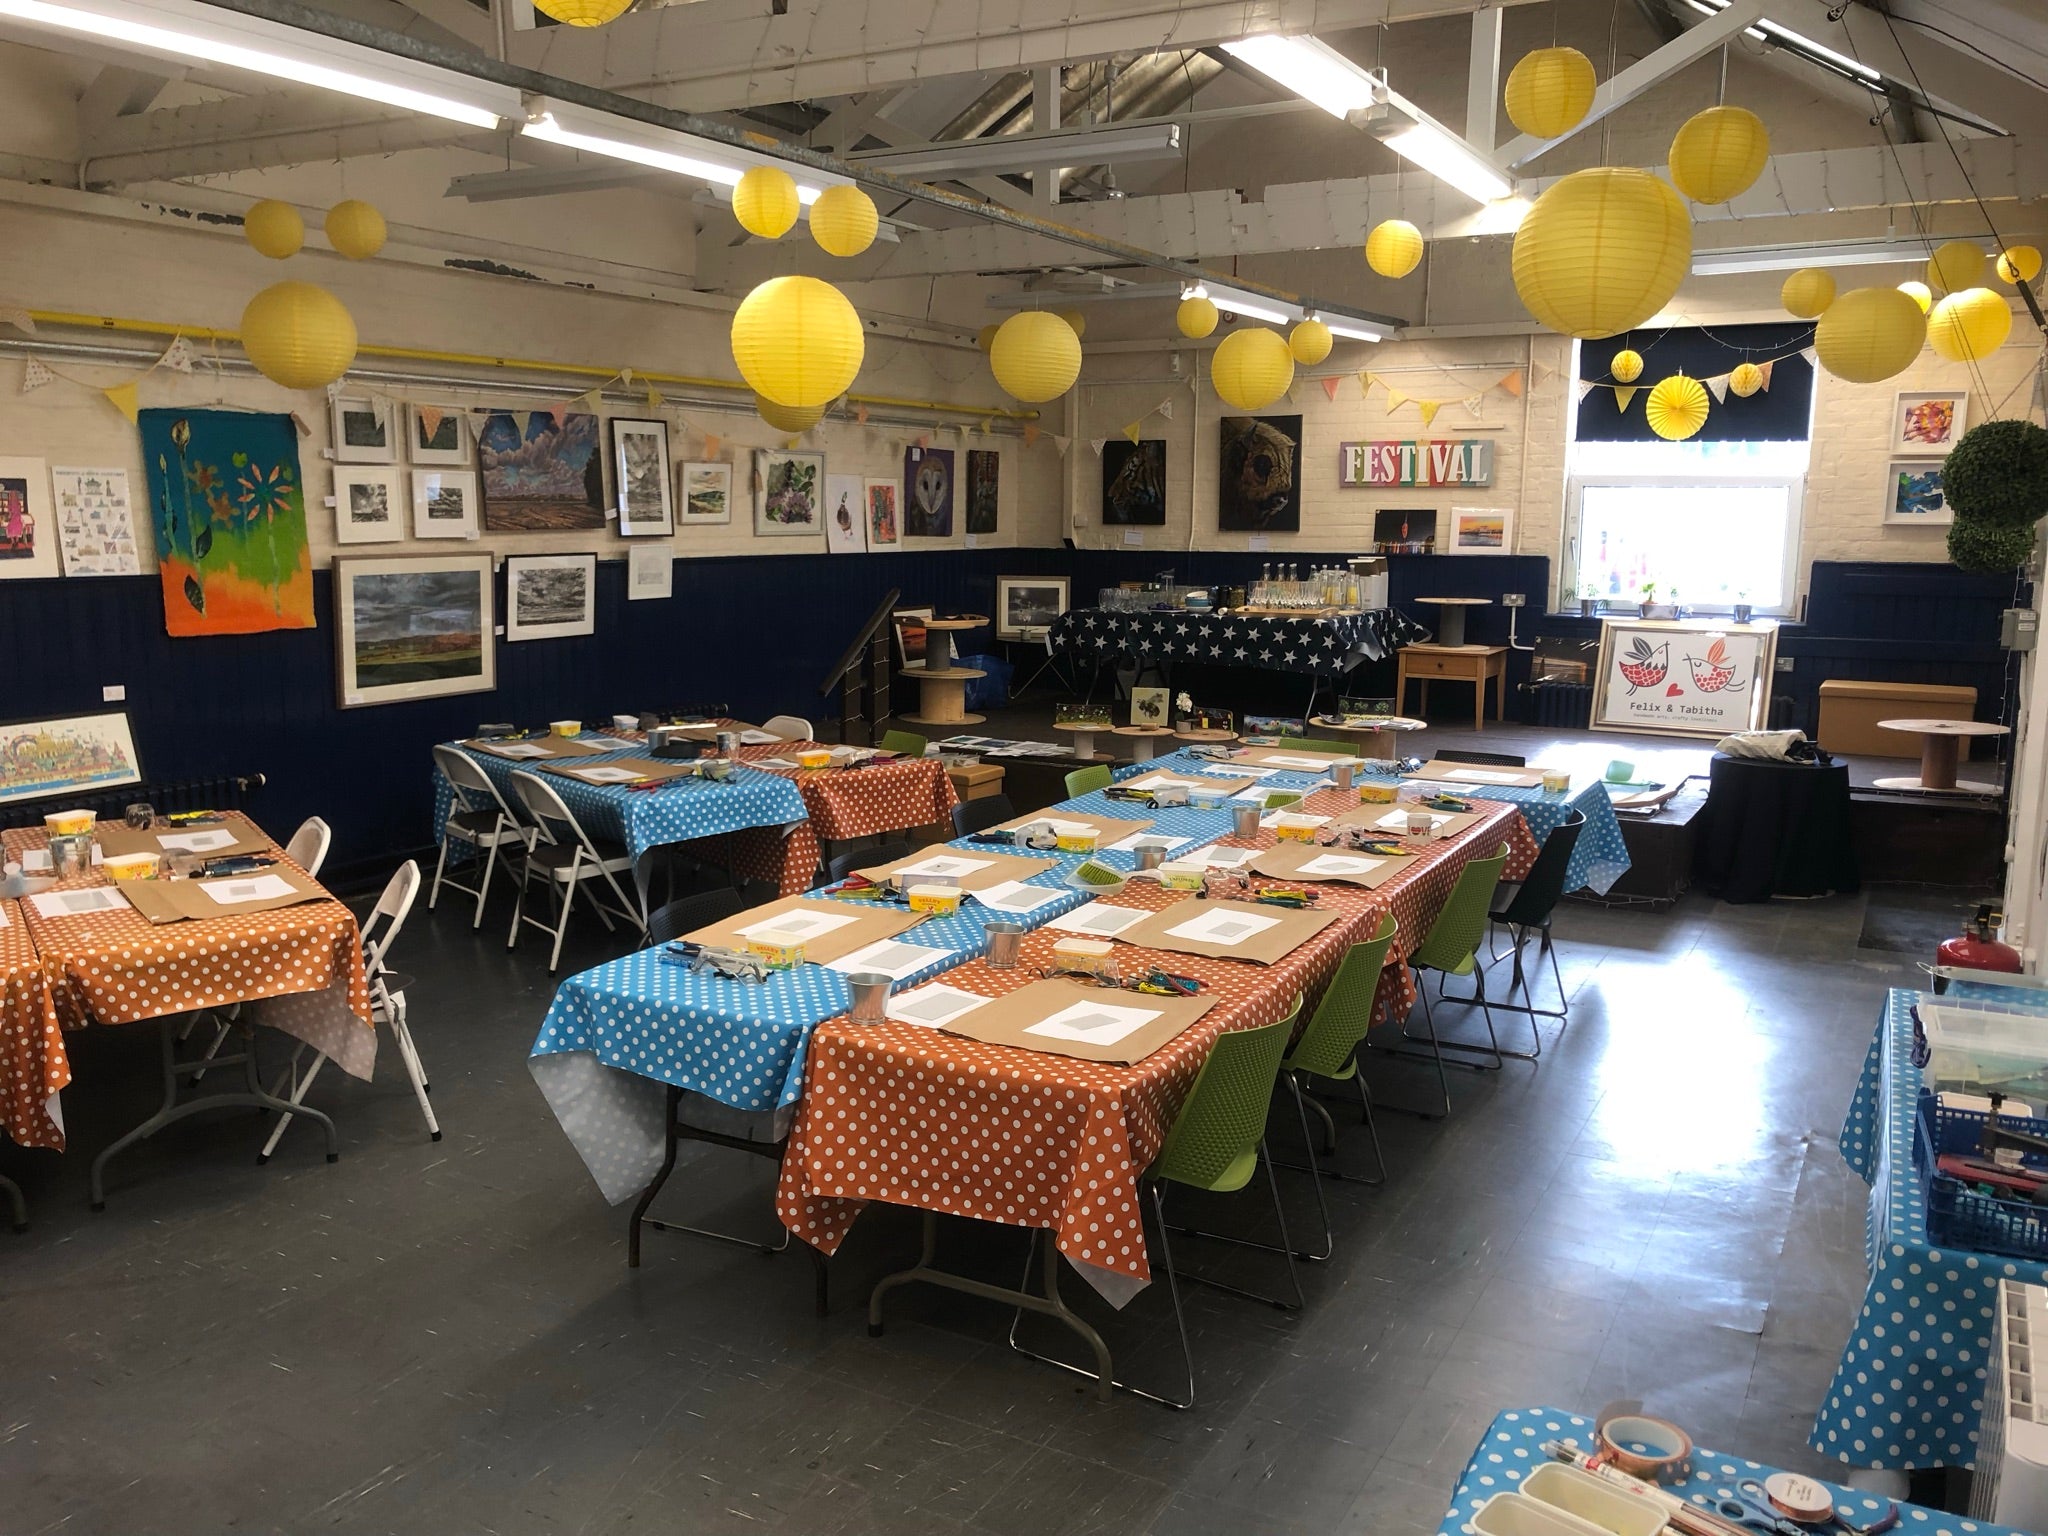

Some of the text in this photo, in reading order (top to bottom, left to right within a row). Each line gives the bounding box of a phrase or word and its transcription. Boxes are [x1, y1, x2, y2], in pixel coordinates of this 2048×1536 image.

[1344, 444, 1488, 483] FESTIVAL
[1630, 702, 1724, 716] Felix & Tabitha
